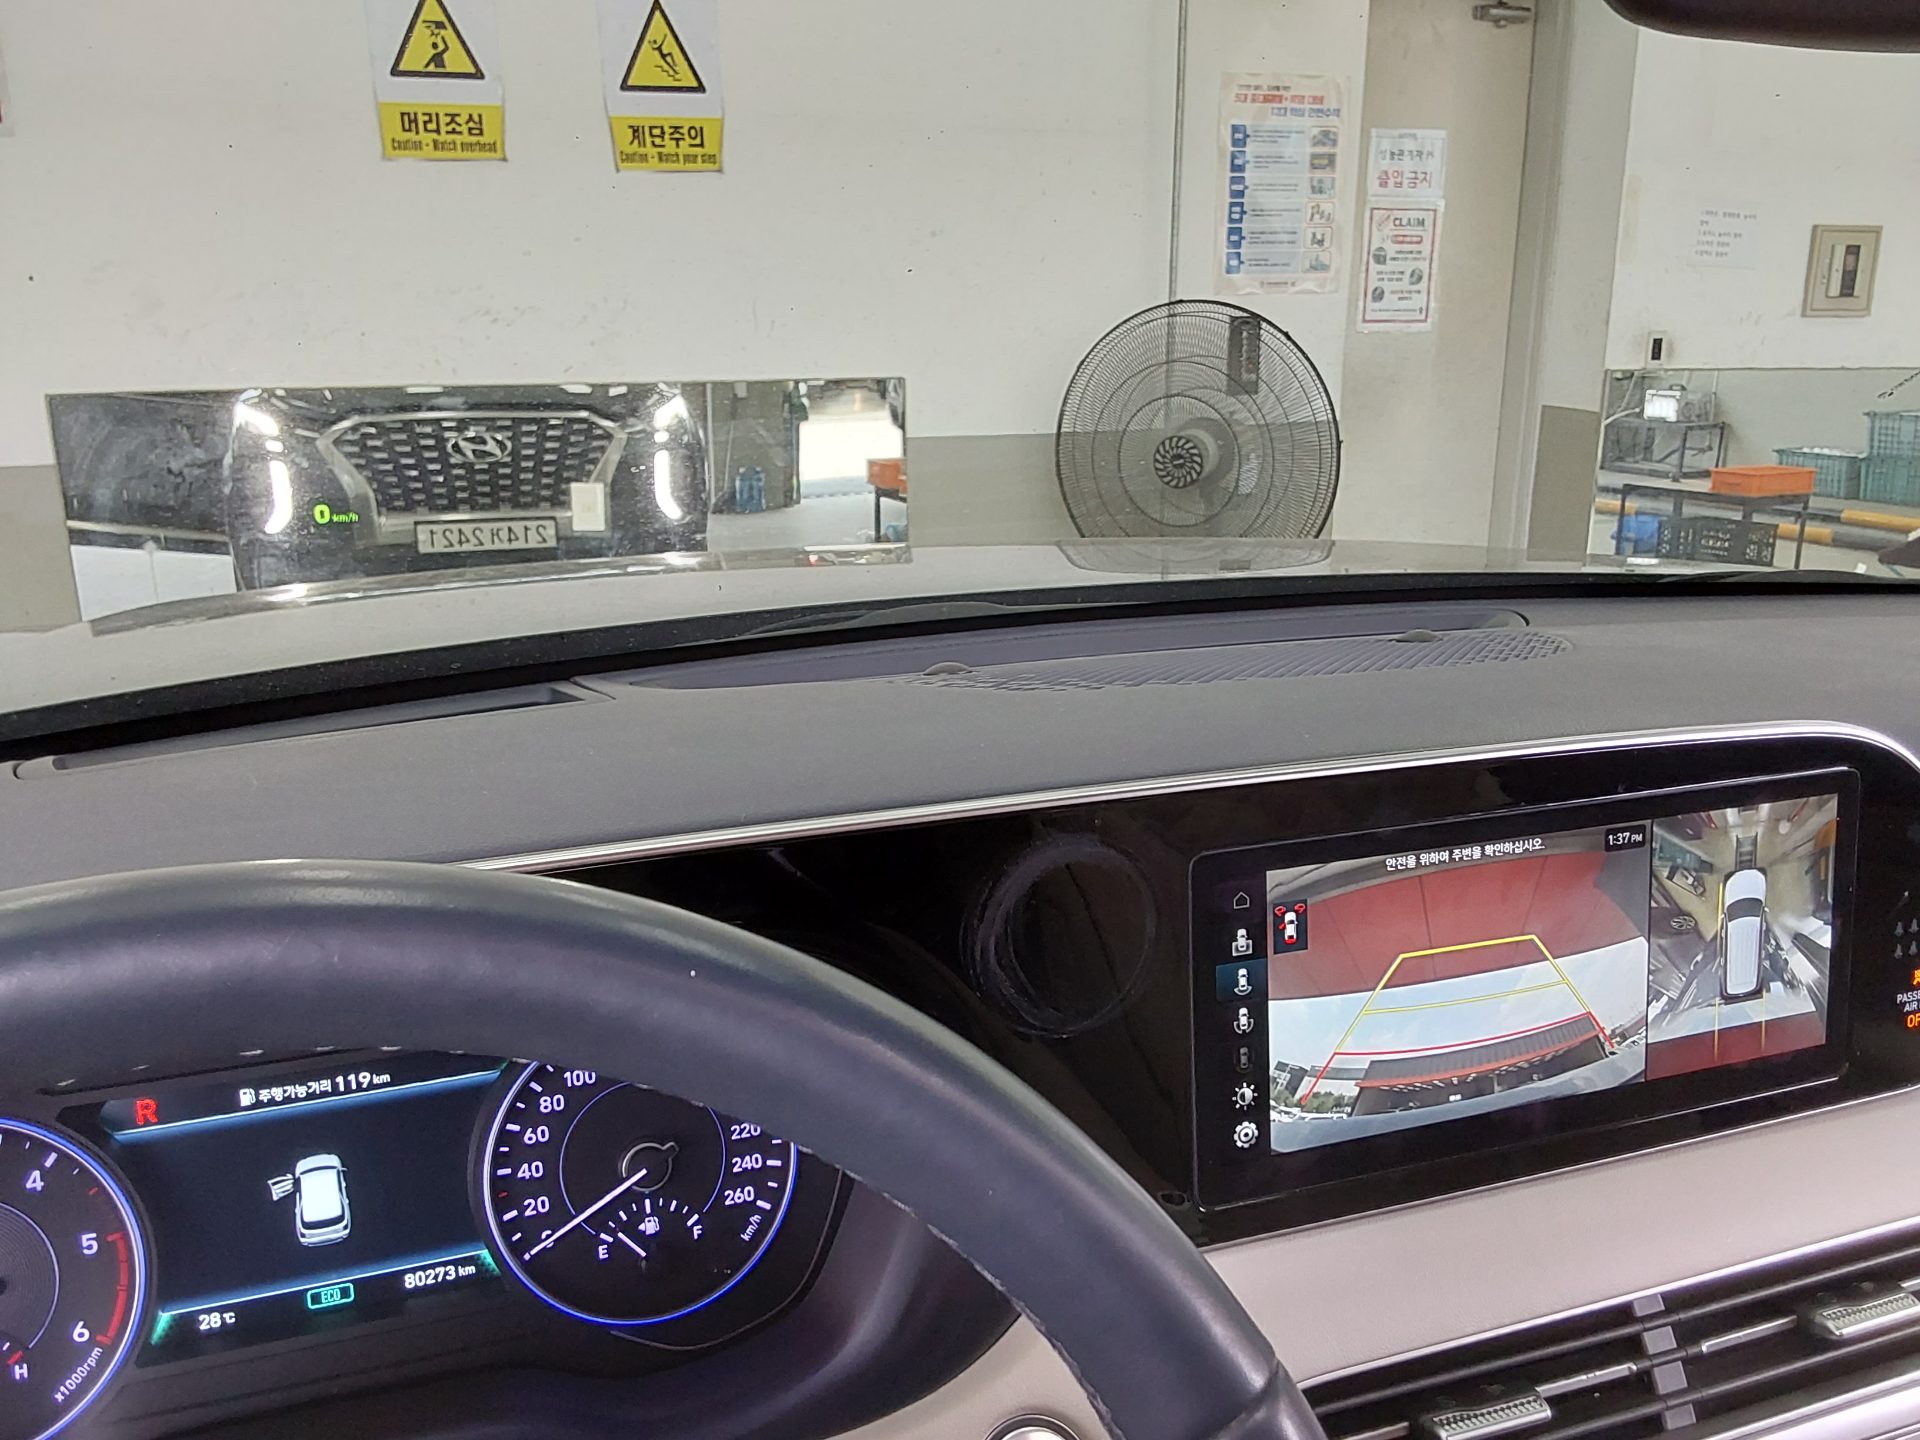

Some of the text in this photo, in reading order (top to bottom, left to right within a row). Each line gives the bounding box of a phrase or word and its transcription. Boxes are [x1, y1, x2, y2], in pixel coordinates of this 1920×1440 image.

[400, 111, 484, 137] 머리조심
[392, 138, 423, 151] Caution
[432, 138, 457, 152] Watch
[460, 140, 498, 154] overhead
[628, 125, 705, 148] 계단주의
[620, 150, 648, 164] Caution
[657, 151, 680, 164] Watch
[1376, 170, 1432, 189] 출입금지
[1392, 217, 1425, 228] CLAIM
[1608, 832, 1643, 846] 1:37 PM
[1386, 838, 1546, 872] 안전을 위하여 주변을 확인하십시오.
[258, 1072, 390, 1103] 주행가능거리 119 km
[564, 1070, 596, 1088] 100
[136, 1097, 158, 1125] R
[538, 1094, 565, 1113] 80
[524, 1126, 550, 1144] 60
[730, 1124, 761, 1140] 220
[517, 1161, 544, 1180] 40
[732, 1154, 762, 1172] 240
[26, 1170, 44, 1191] 4
[724, 1186, 755, 1206] 260
[524, 1196, 550, 1216] 20
[694, 1226, 703, 1240] F
[740, 1213, 762, 1242] km/h
[80, 1232, 98, 1254] 5
[598, 1244, 608, 1259] E
[404, 1264, 476, 1288] 80273 km
[321, 1288, 340, 1304] ECO
[199, 1312, 221, 1330] 28
[72, 1320, 90, 1342] 6
[14, 1363, 28, 1380] H
[54, 1346, 103, 1403] x1000rpm
